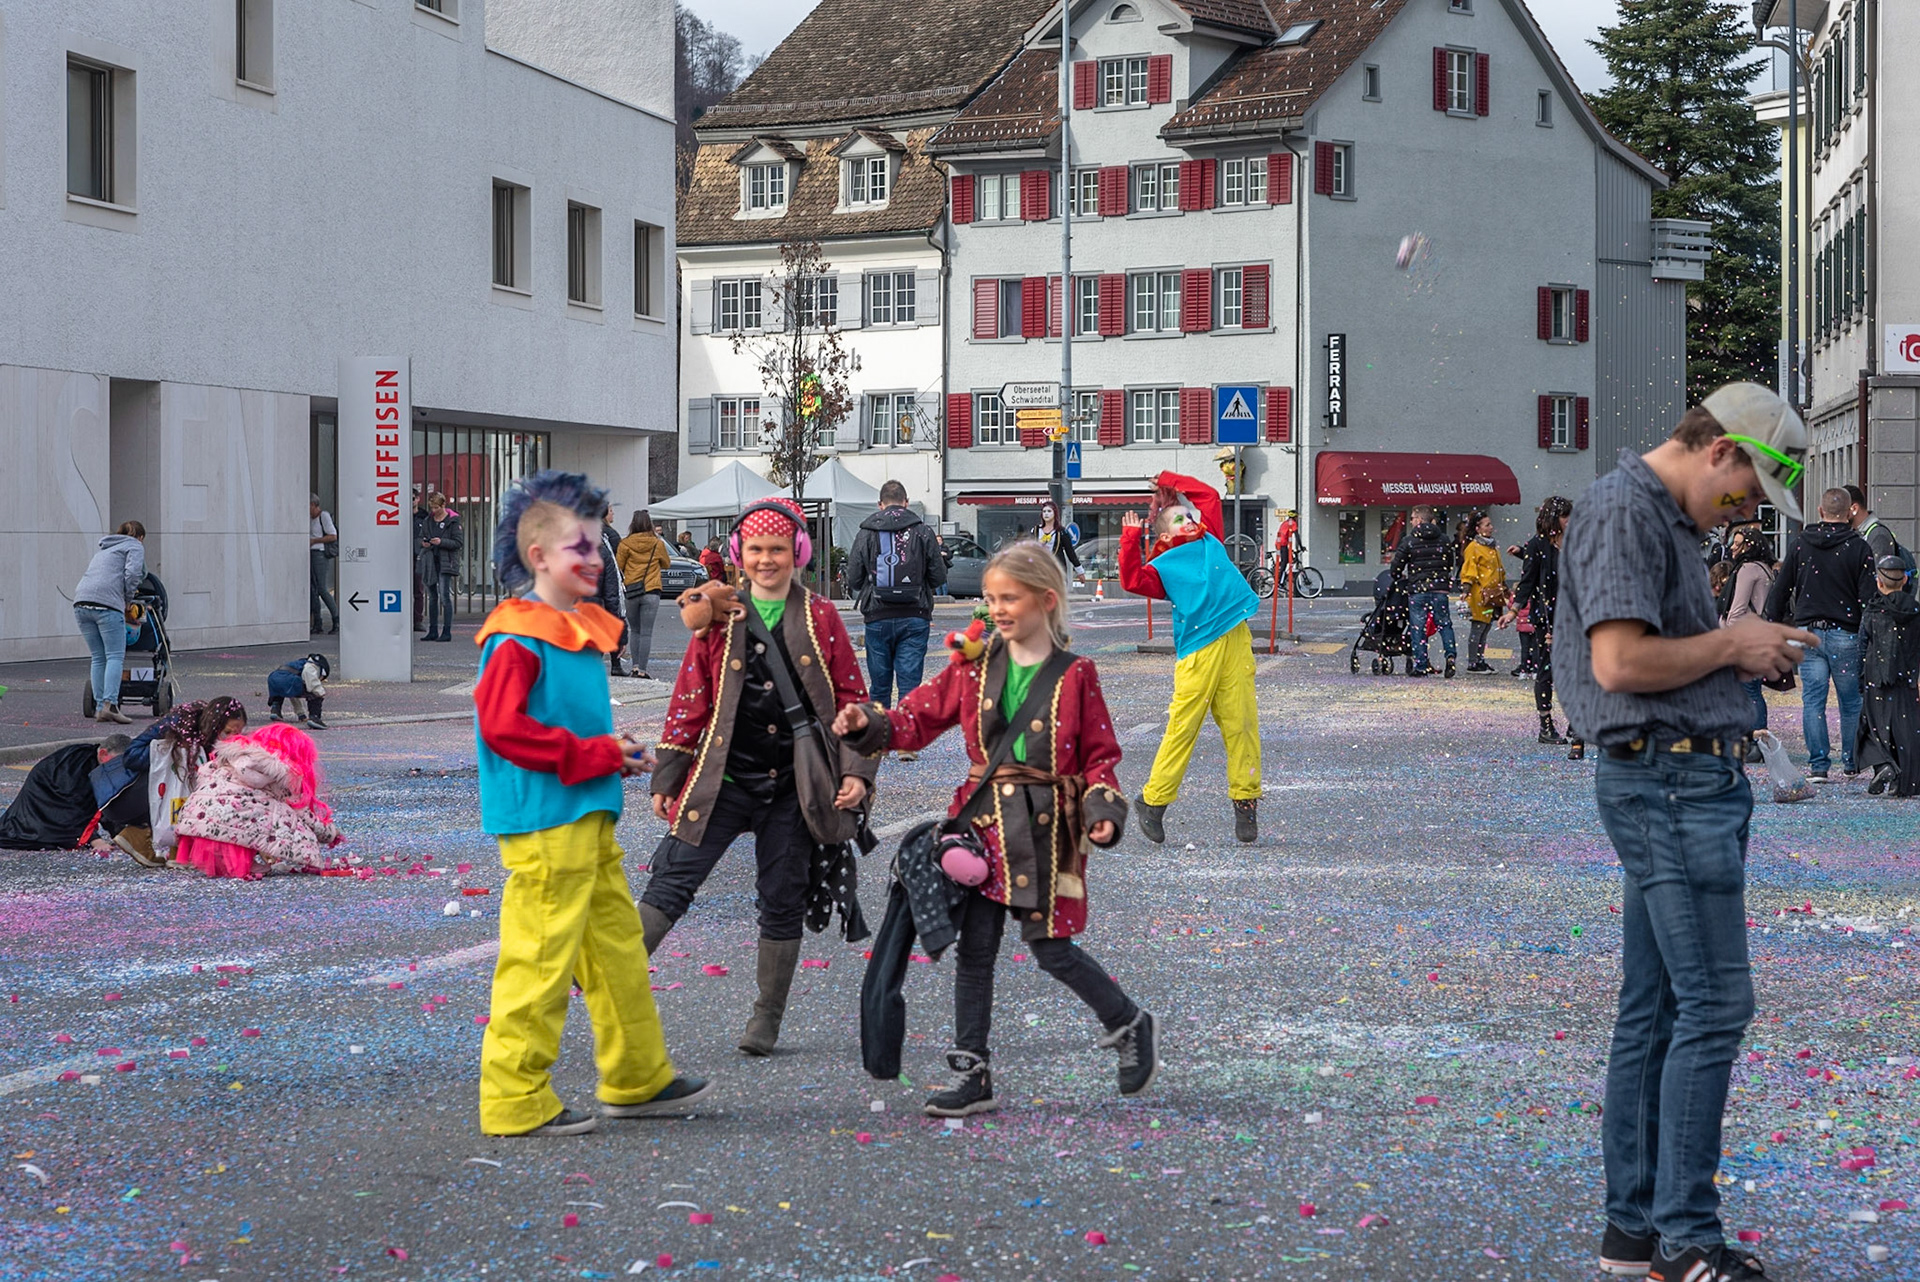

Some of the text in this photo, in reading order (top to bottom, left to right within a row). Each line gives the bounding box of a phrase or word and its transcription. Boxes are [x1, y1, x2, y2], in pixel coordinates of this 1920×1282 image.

[1329, 336, 1341, 426] FERRARI
[1014, 385, 1051, 394] Oberseetal
[376, 370, 400, 526] RAIFFEISEN
[1382, 482, 1494, 494] MESSER HAUSHALT FERRARI
[383, 593, 397, 609] P
